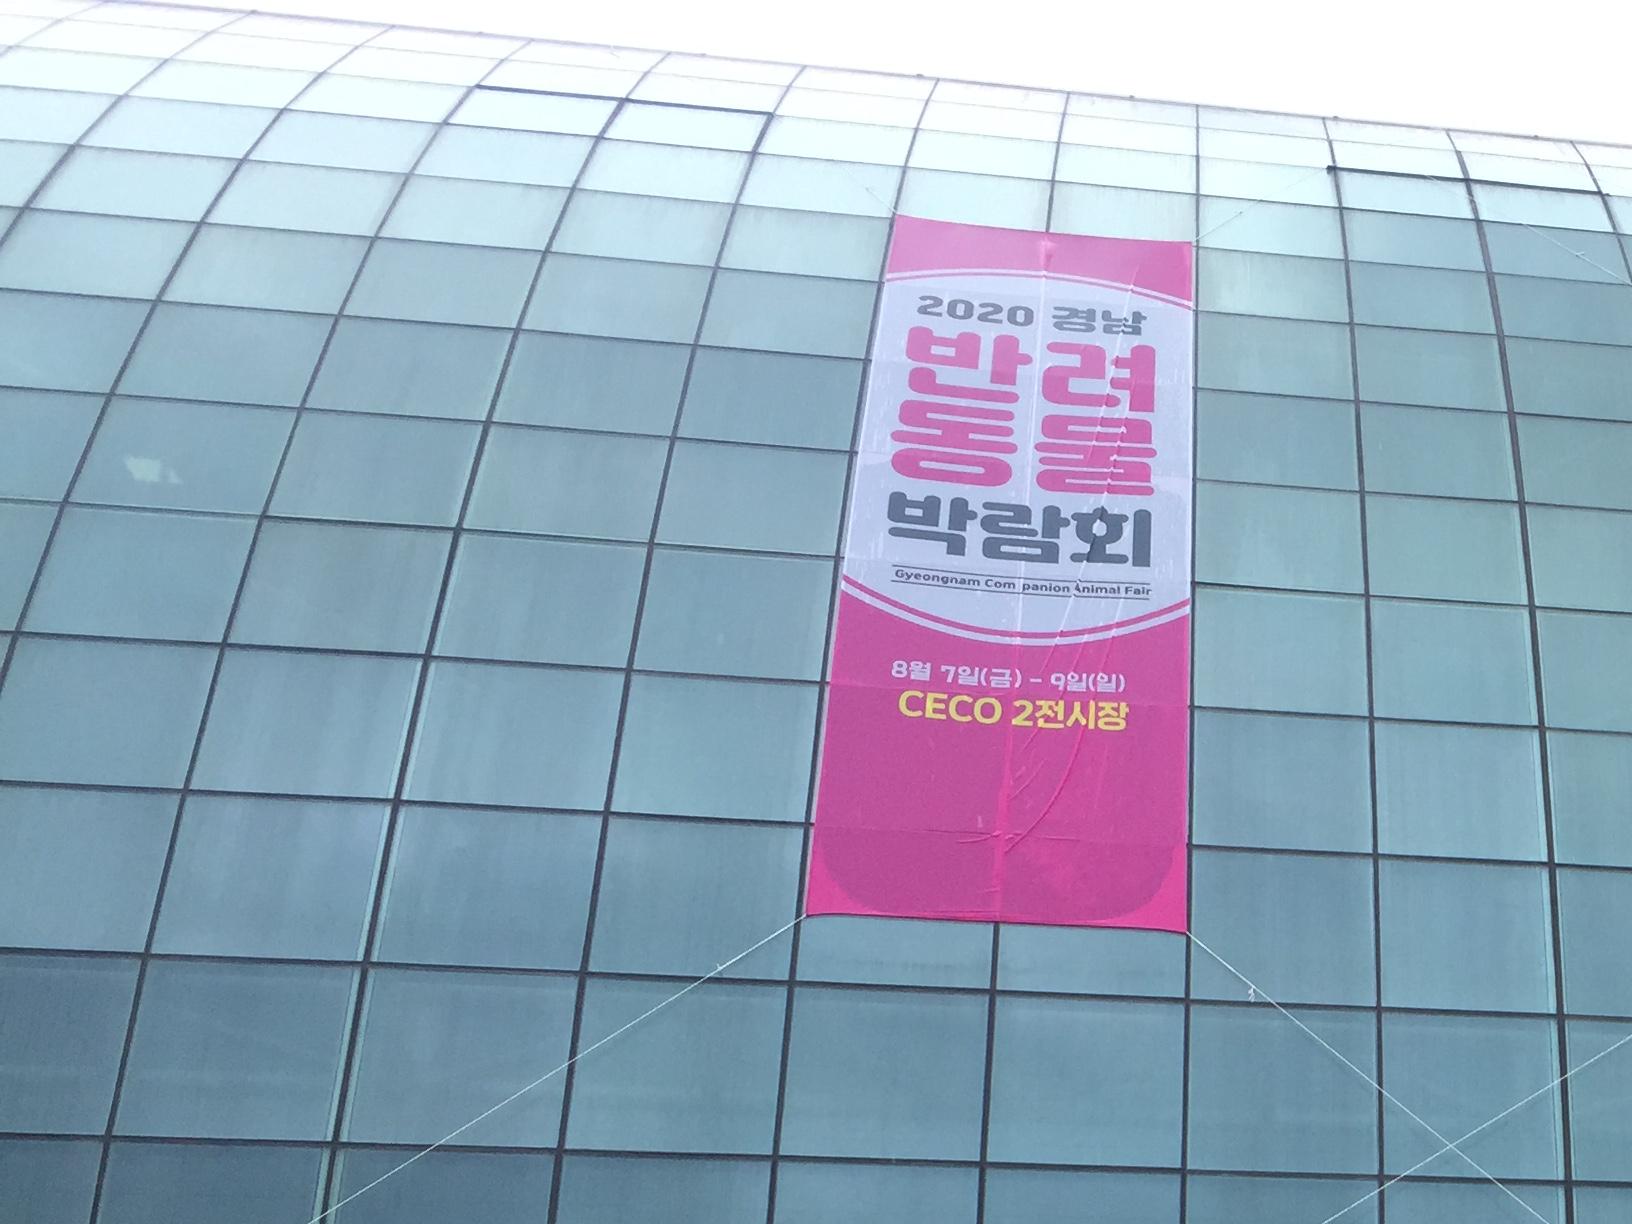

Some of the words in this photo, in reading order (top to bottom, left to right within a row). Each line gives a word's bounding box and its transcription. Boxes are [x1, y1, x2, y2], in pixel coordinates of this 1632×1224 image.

[917, 295, 1034, 327] 2020
[1051, 306, 1147, 337] 경남
[905, 325, 1157, 413] 반려
[890, 398, 1158, 497] 동물
[888, 490, 1152, 568] 박람회
[894, 568, 981, 588] Gyeongnam
[1074, 582, 1120, 596] Animal
[1124, 585, 1153, 597] Fair
[890, 659, 933, 682] 8월
[940, 665, 1023, 689] 7일(금)
[1049, 672, 1127, 694] 9일(일)
[897, 690, 1003, 725] CECO
[1010, 700, 1130, 732] 2전시장
